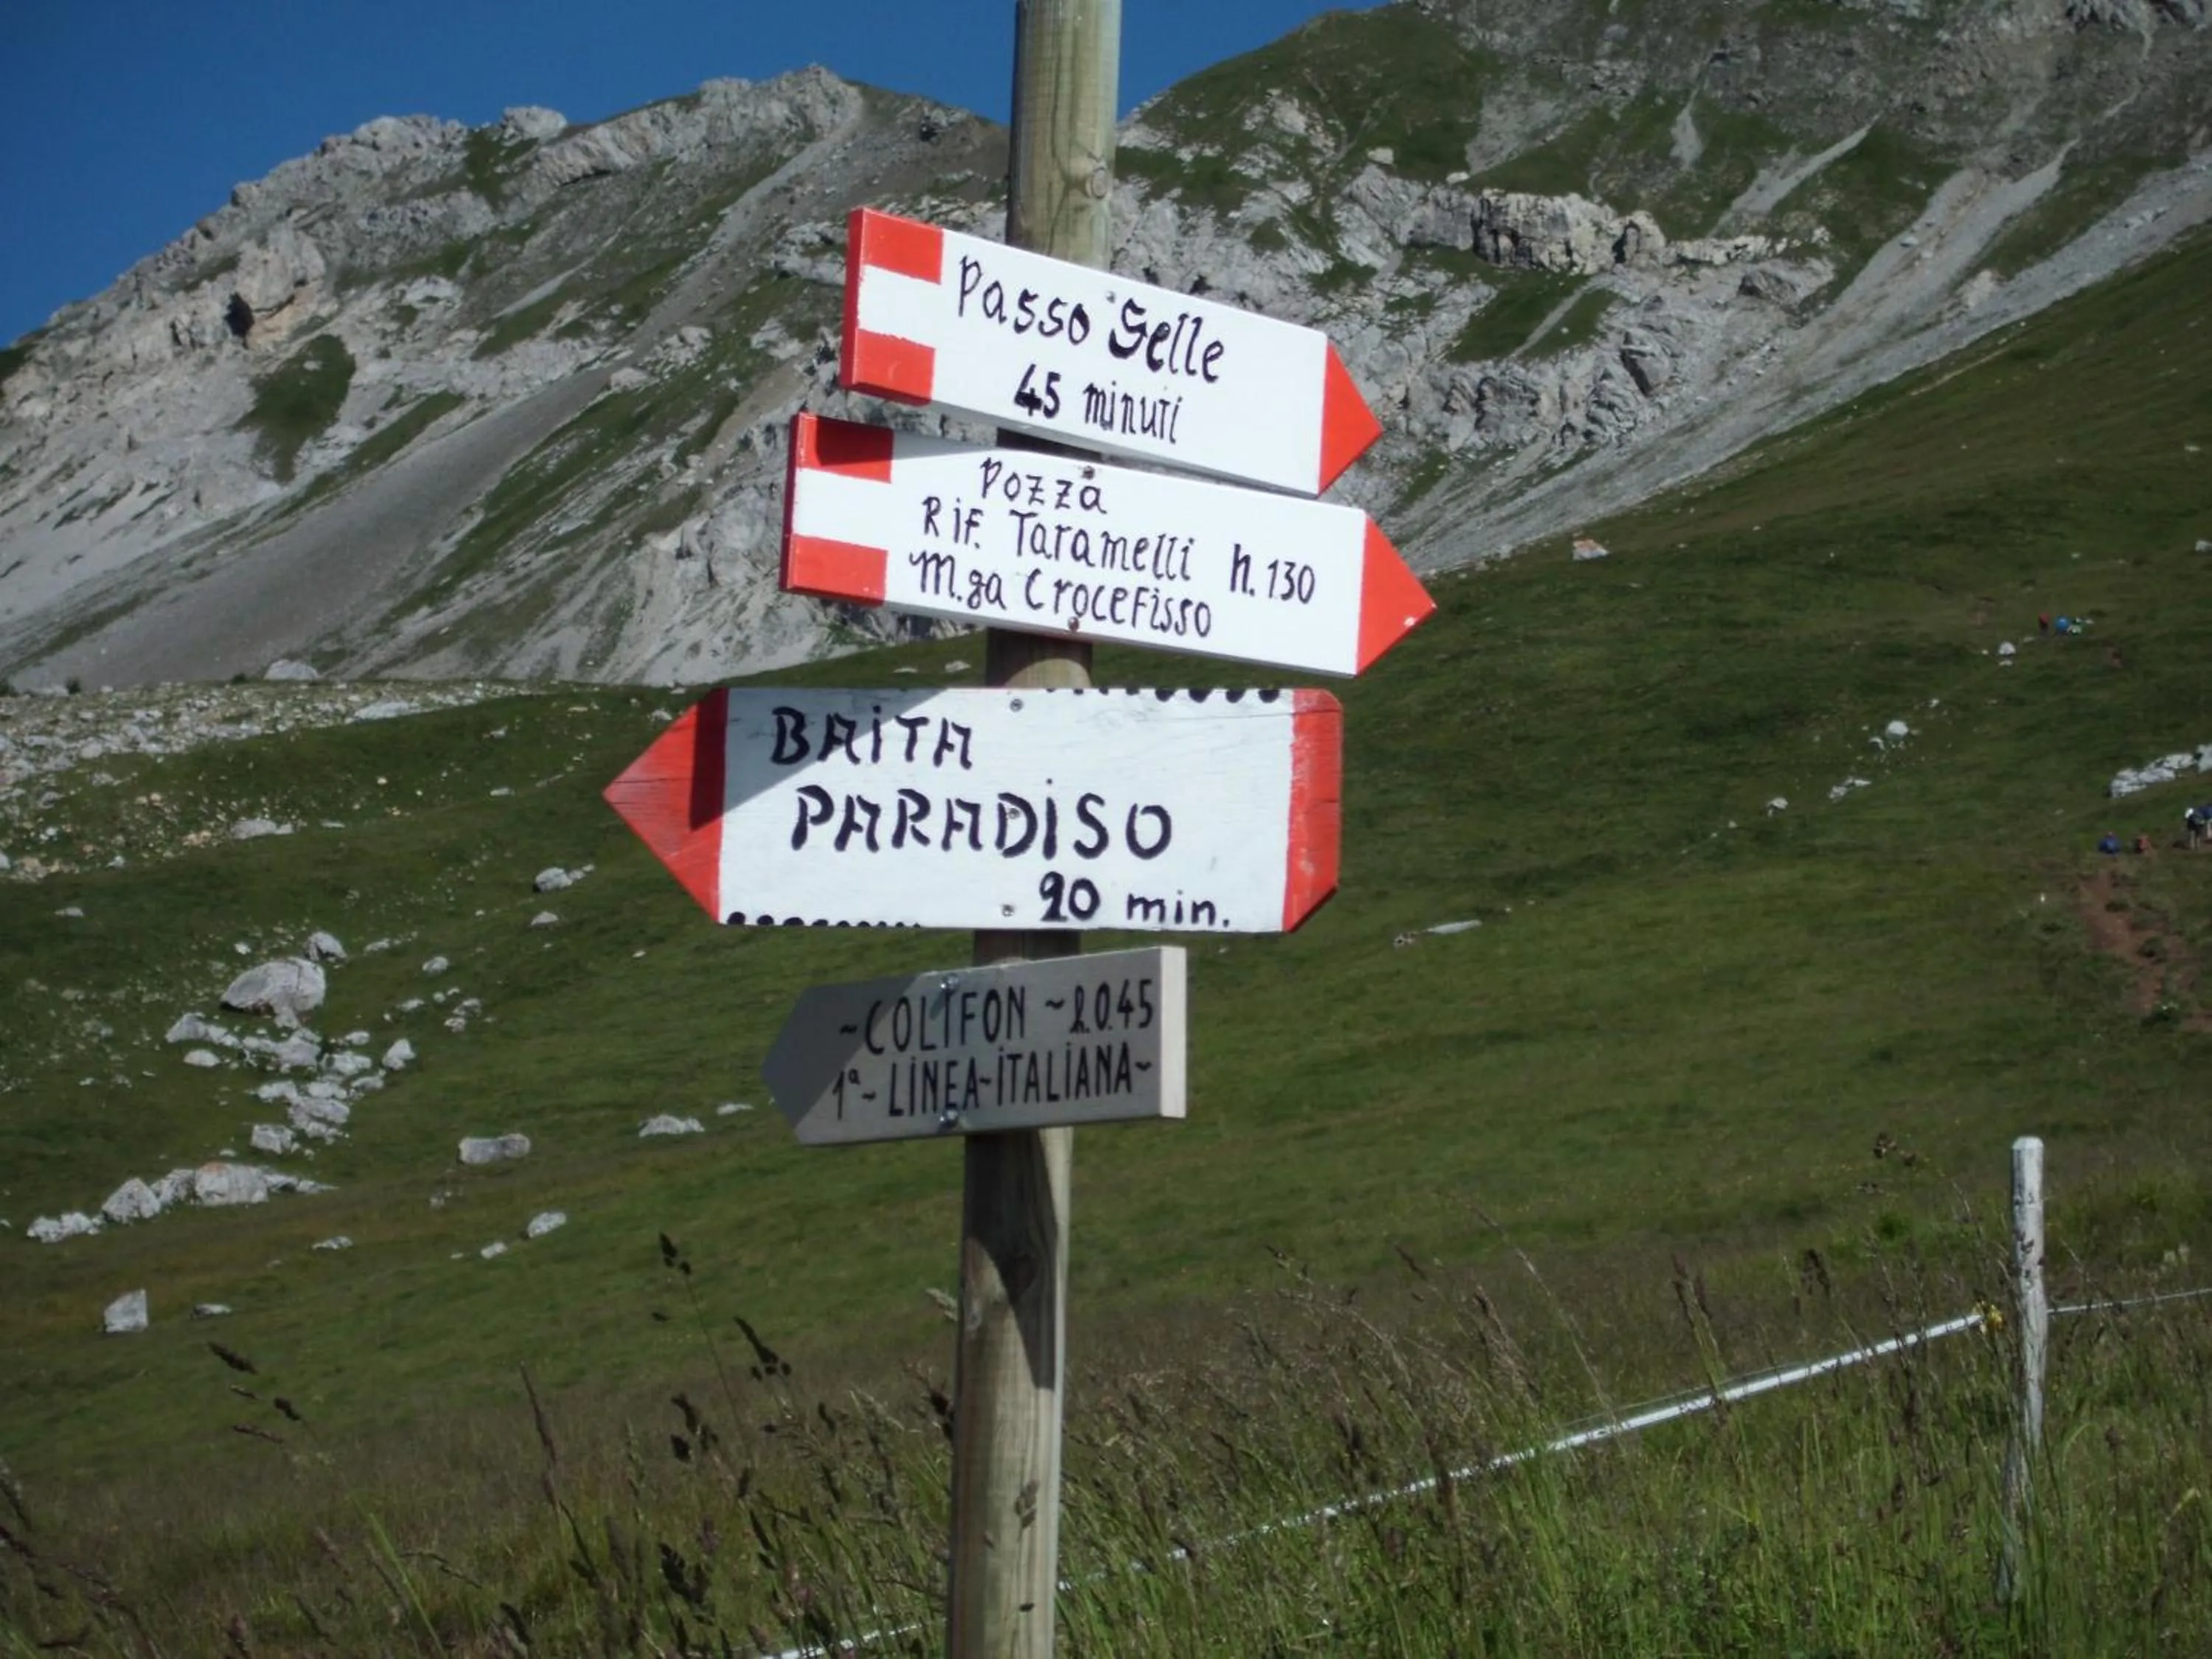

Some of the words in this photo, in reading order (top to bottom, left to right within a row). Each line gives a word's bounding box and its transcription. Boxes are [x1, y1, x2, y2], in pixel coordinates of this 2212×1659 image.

[959, 255, 1090, 345] Passo
[1109, 298, 1224, 383] Selle
[1015, 364, 1060, 418] 45
[1083, 380, 1183, 443] minuti
[980, 457, 1107, 514] Pozza
[1009, 509, 1194, 580] Taramelli
[1025, 568, 1211, 637] Crocefisso
[769, 705, 973, 770] BAITA
[791, 778, 1172, 860] PARADISO
[1126, 890, 1230, 927] min.
